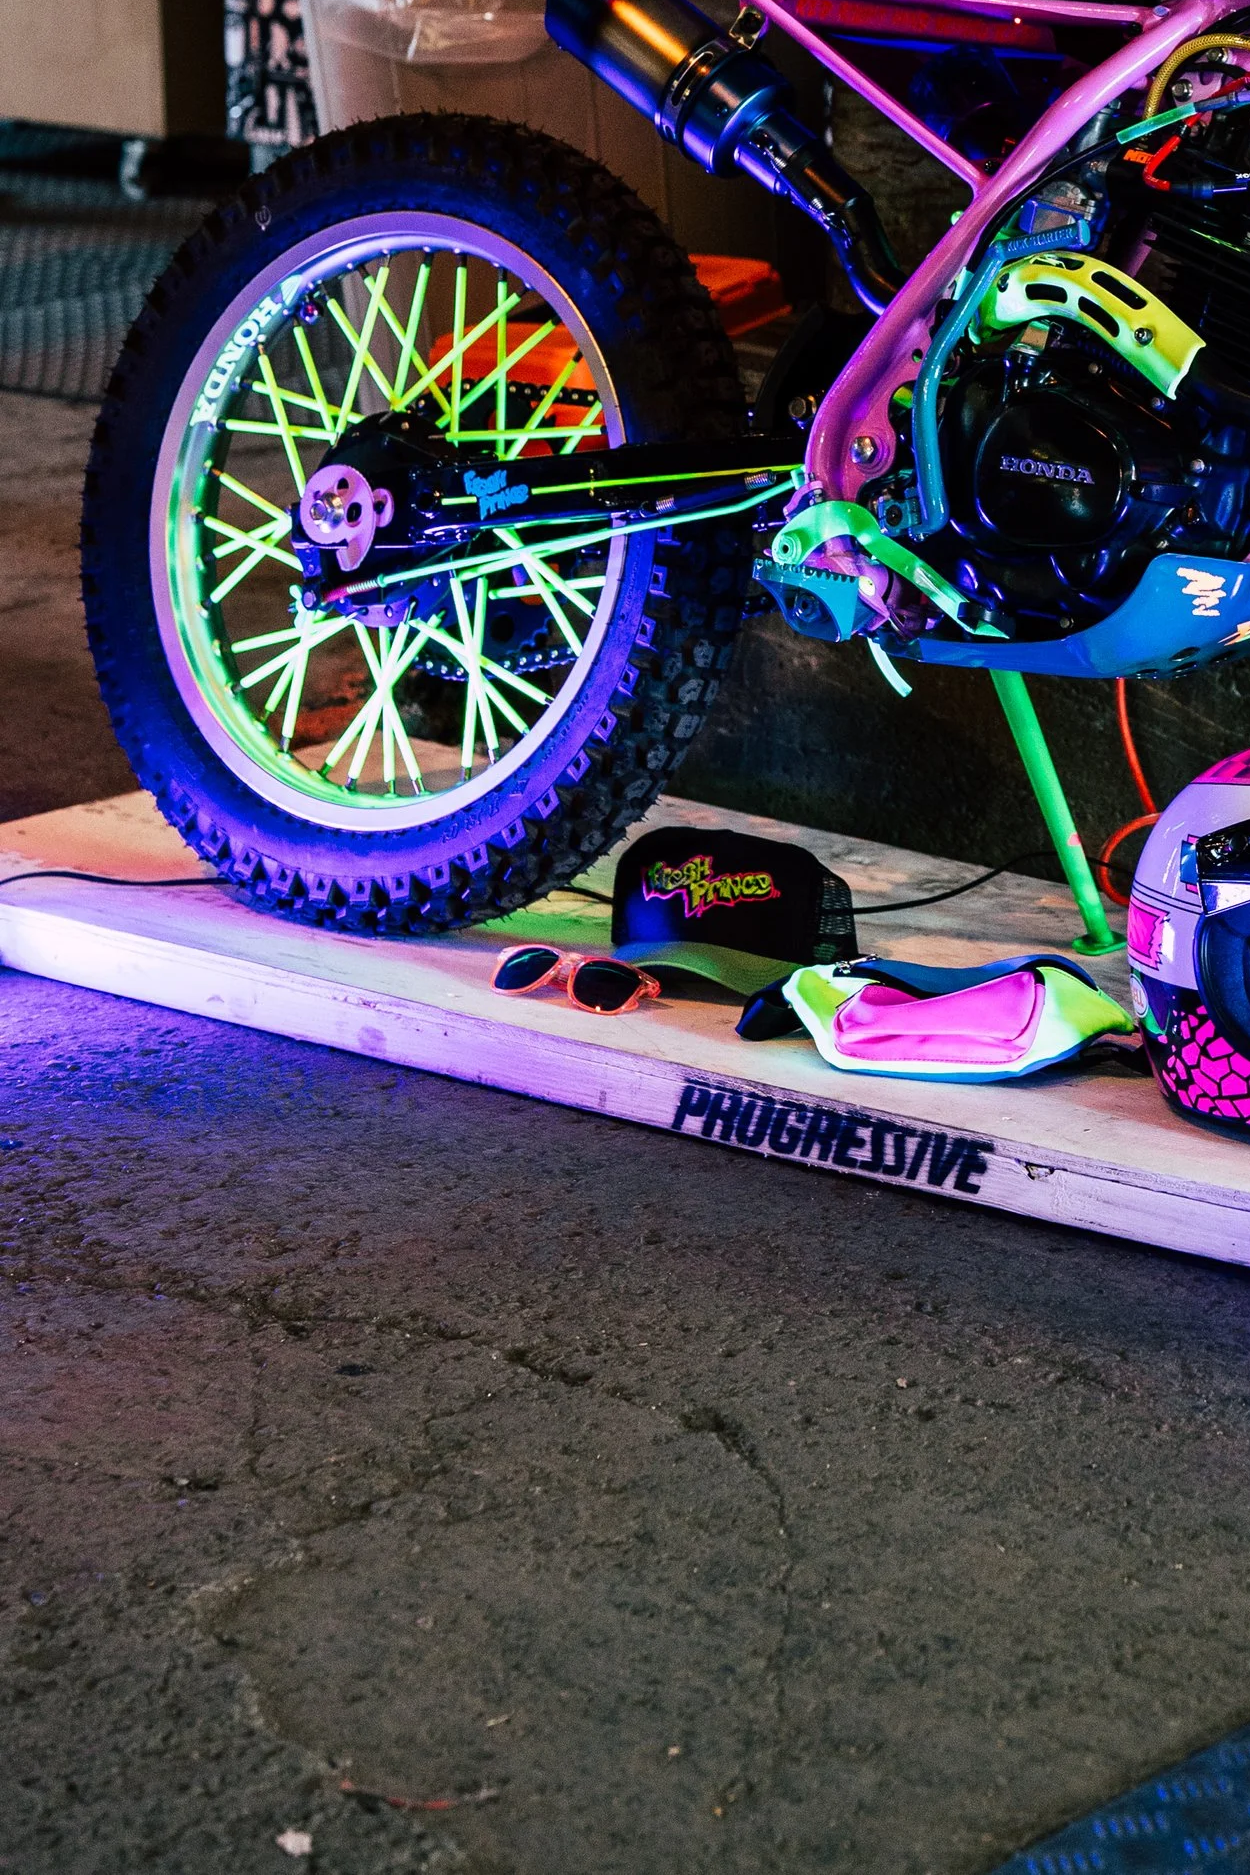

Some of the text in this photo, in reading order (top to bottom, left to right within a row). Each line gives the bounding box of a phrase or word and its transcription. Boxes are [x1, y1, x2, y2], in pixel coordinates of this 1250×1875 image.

[189, 295, 283, 426] HONDA
[1000, 455, 1095, 484] HONDA
[672, 1076, 992, 1196] PROGRESSIVE
